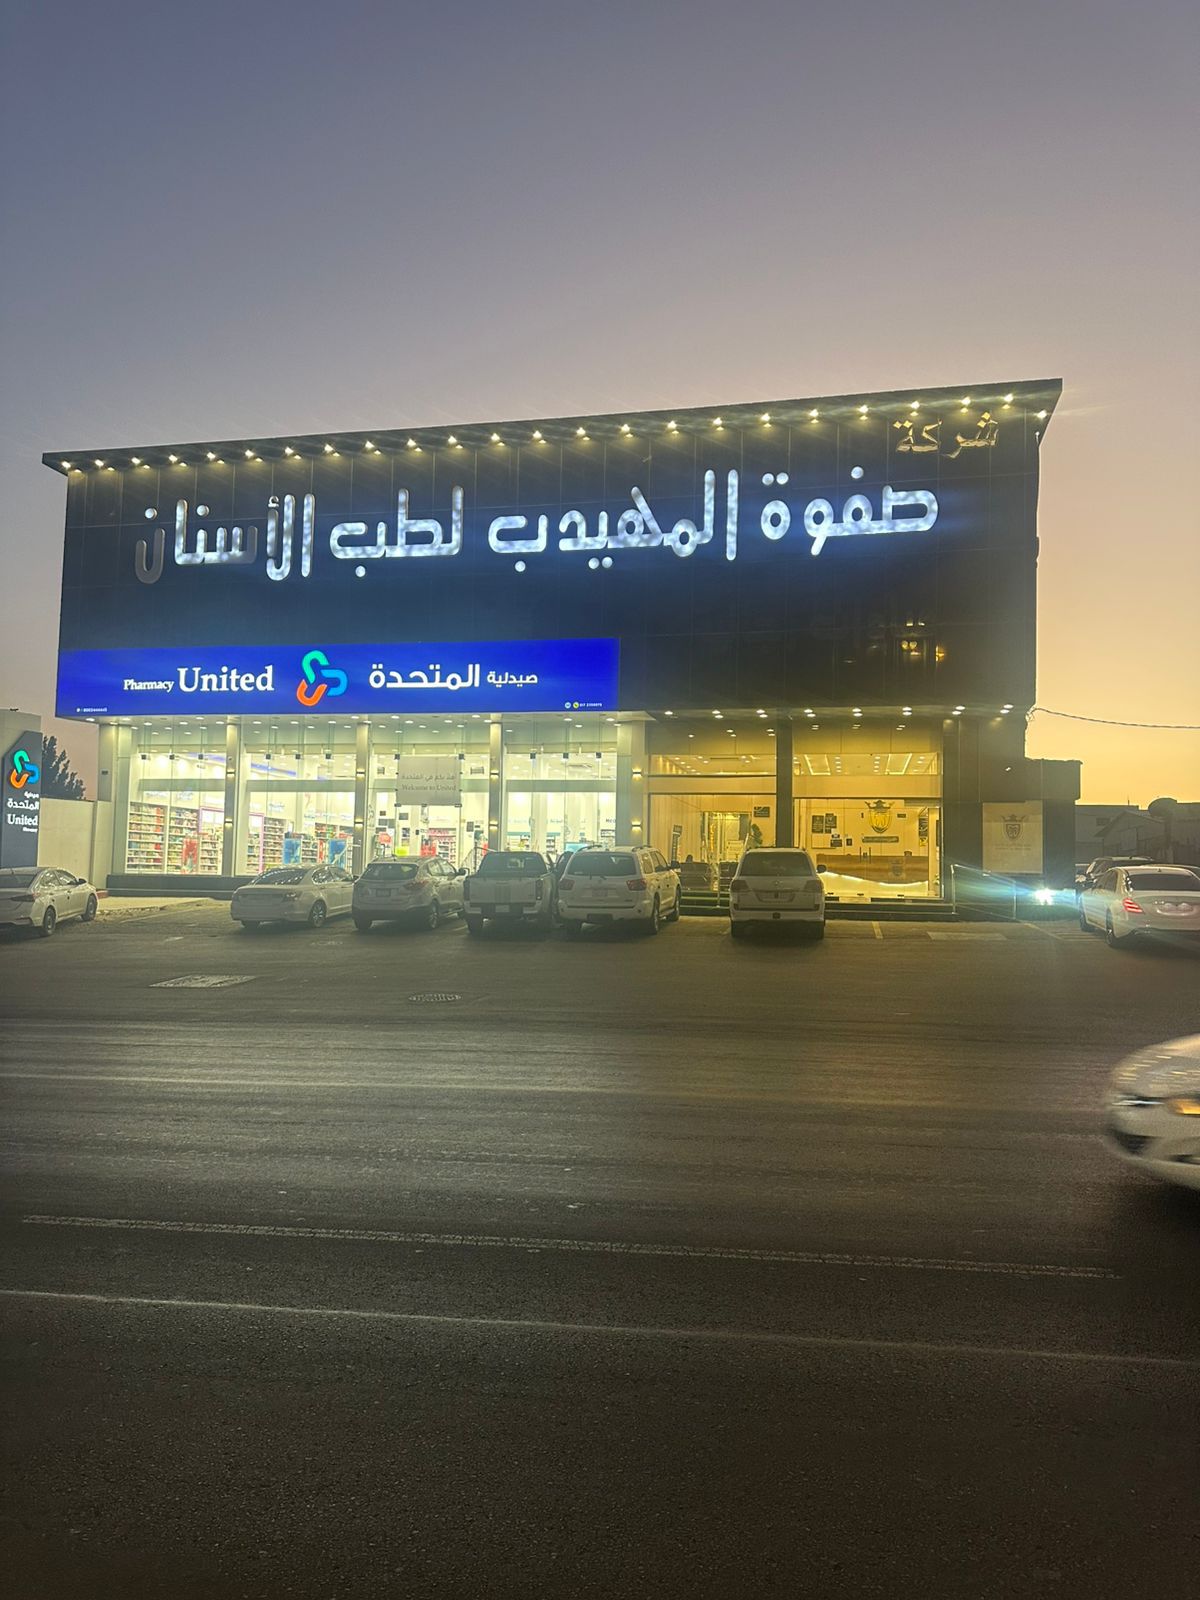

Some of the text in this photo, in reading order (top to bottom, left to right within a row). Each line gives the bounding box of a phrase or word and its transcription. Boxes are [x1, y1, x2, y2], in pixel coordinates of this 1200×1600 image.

[893, 411, 999, 459] شركة
[134, 465, 940, 585] صفوة المهيدب لطب الأسنان
[123, 665, 275, 693] Pharmacy United
[369, 663, 538, 690] صيدلية المتحدة
[7, 798, 39, 810] المتحدة
[7, 813, 38, 825] United
